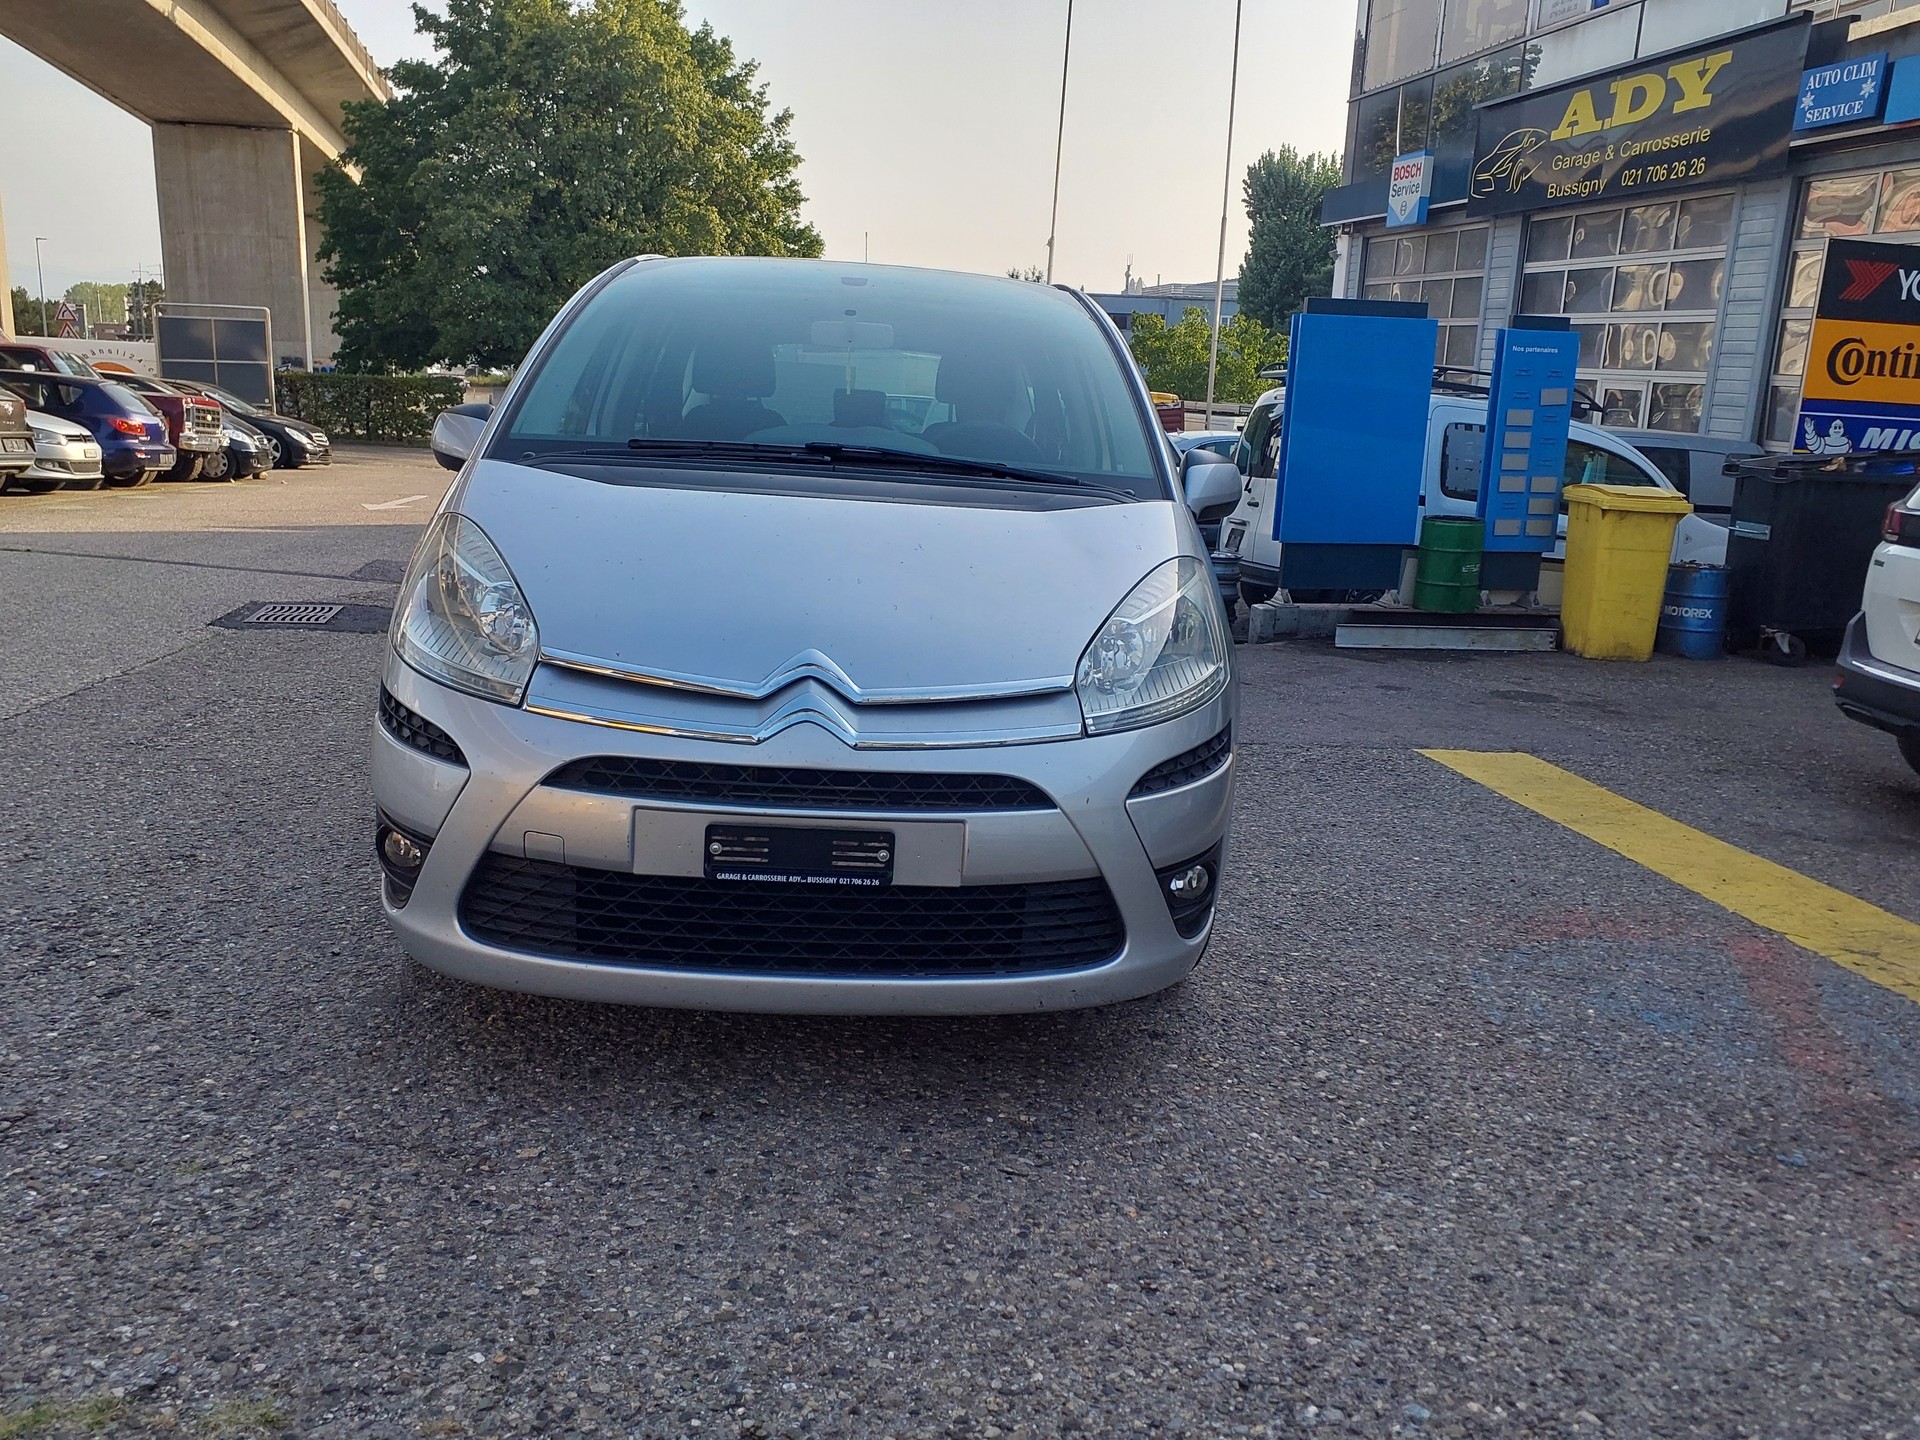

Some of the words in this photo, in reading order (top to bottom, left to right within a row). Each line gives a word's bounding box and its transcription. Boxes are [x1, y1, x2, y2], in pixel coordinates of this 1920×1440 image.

[1805, 68, 1841, 91] AUTO
[1843, 60, 1878, 82] CLIM
[1804, 100, 1864, 123] SERVICE
[1552, 150, 1601, 171] Garage
[1605, 144, 1615, 161] &
[1620, 125, 1711, 158] Carrosserie
[1393, 162, 1423, 182] BOSCH
[1547, 177, 1607, 199] Bussigny
[1621, 167, 1643, 187] 021
[1646, 163, 1668, 183] 706
[1670, 160, 1686, 180] 26
[1689, 156, 1707, 177] 26
[1391, 181, 1421, 198] Service
[1664, 605, 1713, 619] MOTOREX
[716, 872, 741, 880] GARAGE
[748, 874, 787, 882] CARROSSERIE
[788, 875, 801, 883] ADY
[807, 876, 838, 884] BUSSIGNY
[839, 877, 850, 885] 021
